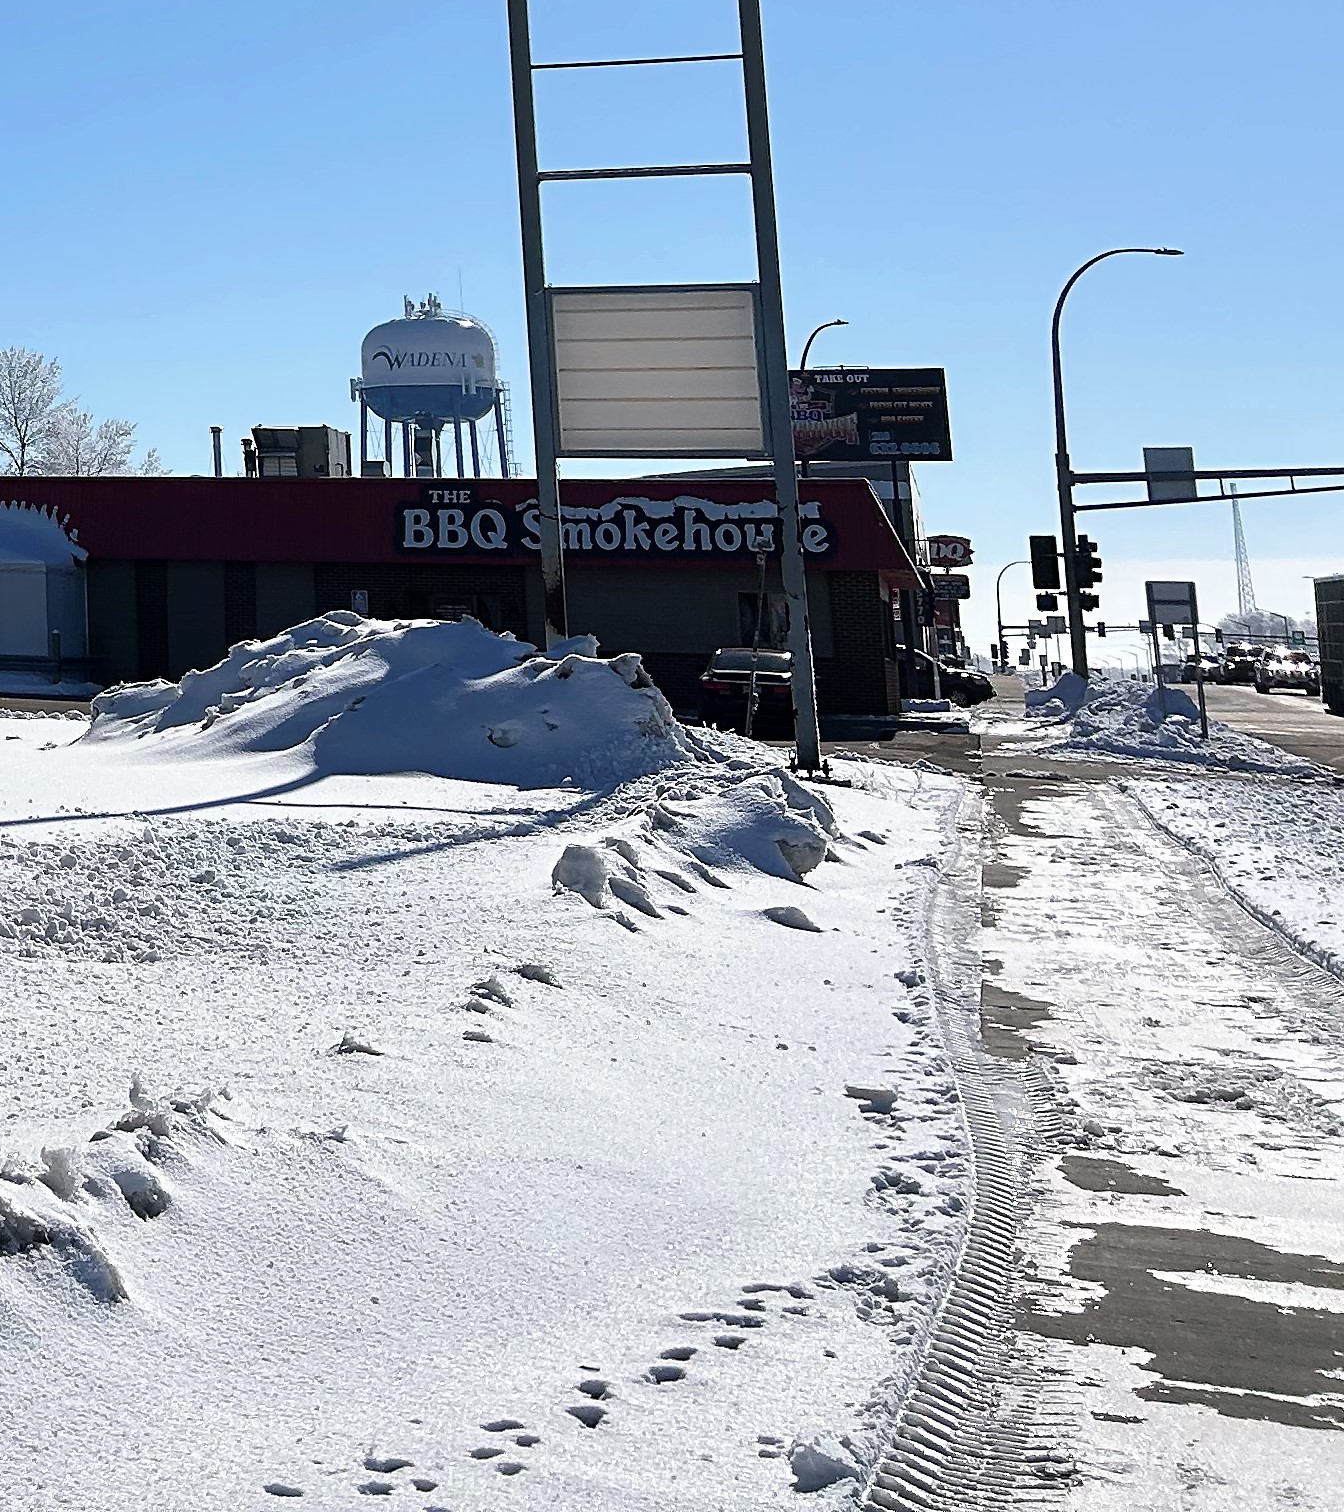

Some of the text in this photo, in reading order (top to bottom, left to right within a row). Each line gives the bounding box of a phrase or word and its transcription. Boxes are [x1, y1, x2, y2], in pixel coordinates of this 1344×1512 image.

[373, 347, 467, 371] WADENA
[814, 374, 870, 383] TAKE OUT
[429, 490, 471, 503] THE
[403, 508, 829, 552] BBQ Smokehoue
[930, 542, 965, 561] DQ
